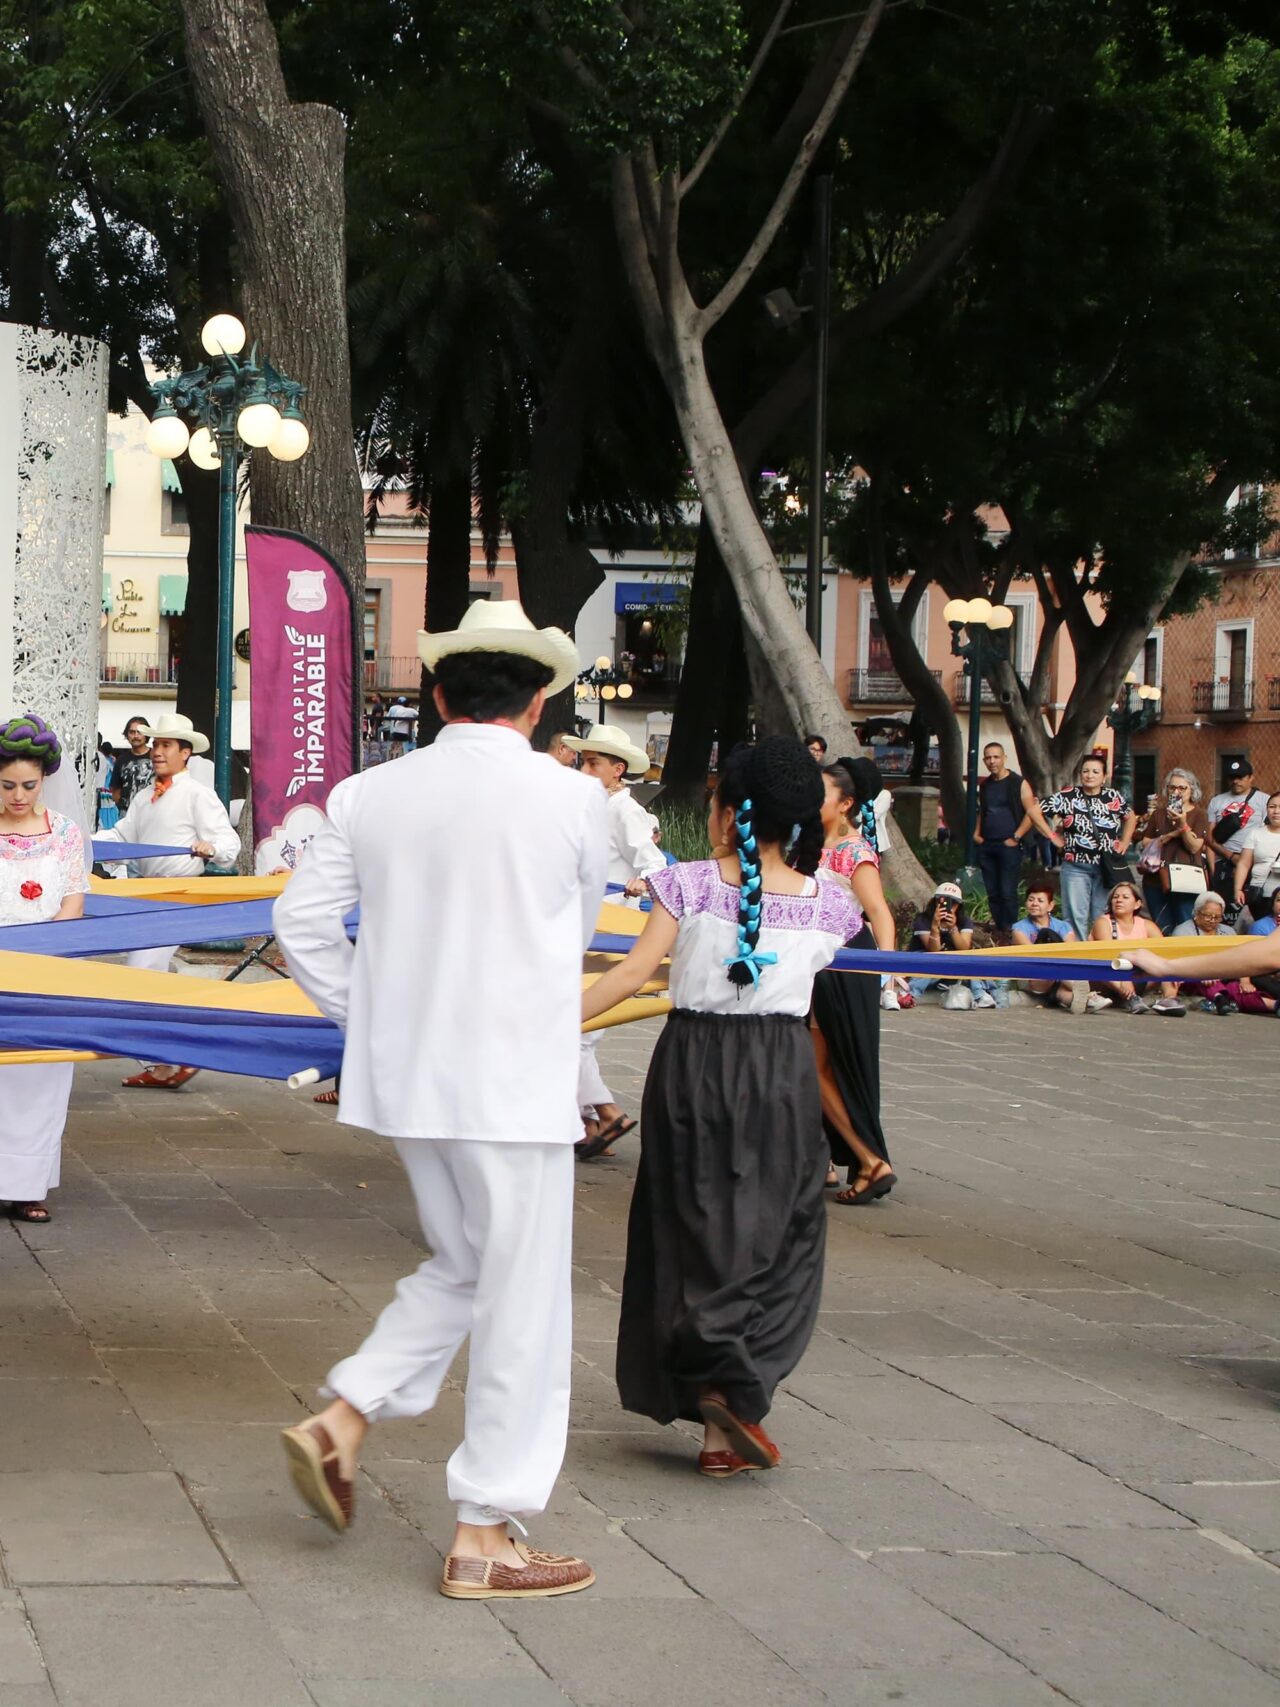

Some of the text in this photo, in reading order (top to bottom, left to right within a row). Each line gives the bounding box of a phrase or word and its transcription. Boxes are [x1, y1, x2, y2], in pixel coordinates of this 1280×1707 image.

[293, 647, 305, 773] LA CAPITAL
[307, 634, 325, 782] IMPARABLE
